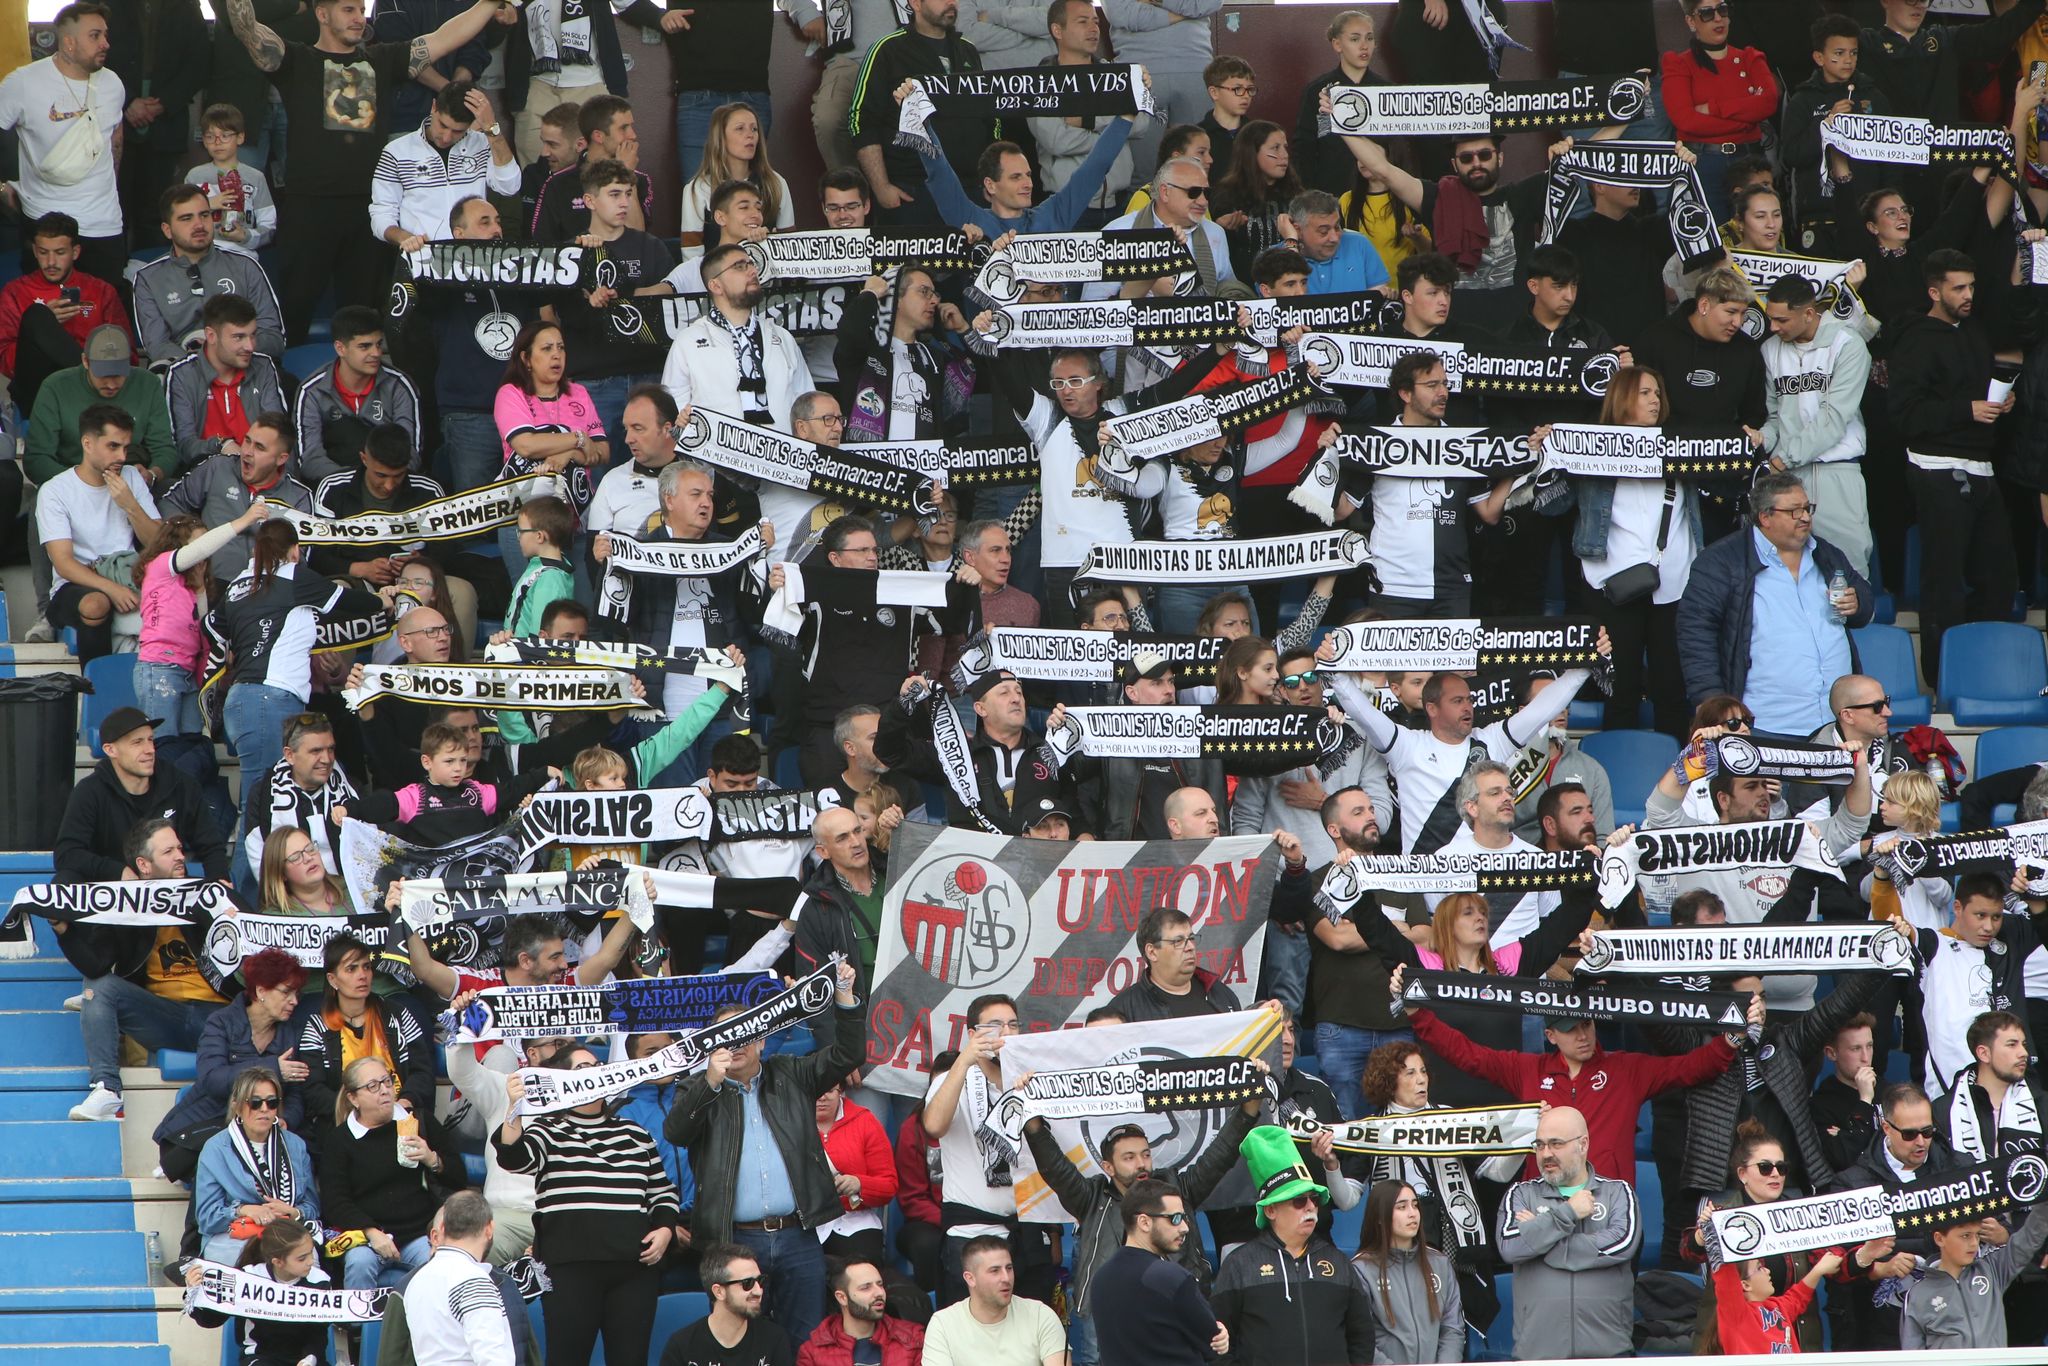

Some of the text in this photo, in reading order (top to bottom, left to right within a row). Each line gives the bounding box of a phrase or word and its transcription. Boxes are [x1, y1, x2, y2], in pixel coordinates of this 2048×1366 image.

[1087, 72, 1128, 93] VDS
[995, 96, 1059, 110] 1923 2013
[1379, 86, 1599, 117] UNIONISTAS de Salamanca C.F.
[1431, 122, 1447, 132] VDS
[1904, 122, 2004, 147] de Salamanca
[768, 233, 967, 261] UNIONISTAS de Salamanca C.F.
[1078, 239, 1096, 262] de
[1096, 238, 1170, 262] Salamanca
[402, 244, 583, 286] UNIONISTAS
[1021, 304, 1212, 330] UNIONISTAS de Salamanca
[1254, 300, 1372, 330] de Salamanca C.F.
[1074, 335, 1090, 344] VDS
[1457, 352, 1544, 378] Salamanca
[1546, 356, 1573, 379] C.F.
[1116, 368, 1301, 444] UNIONISTAS de Salamanca C.F.
[1339, 436, 1530, 468] UNIONISTAS
[1551, 430, 1742, 458] UNIONISTAS de Salamanca
[717, 422, 907, 494] UNIONISTAS de Salamanca C.F.
[920, 445, 1027, 472] de Salamanca
[390, 521, 420, 535] DE
[669, 553, 688, 569] DE
[1104, 540, 1328, 572] UNIONISTAS DE SALAMANCA CF
[998, 633, 1084, 661] UNIONISTAS
[1086, 638, 1107, 661] de
[1198, 638, 1224, 660] C.F.
[1361, 625, 1594, 652] UNIONISTAS de Salamanca C.F.
[1052, 667, 1068, 677] VDS
[1414, 658, 1431, 666] VDS
[476, 681, 506, 698] DE
[1489, 678, 1516, 702] C.F.
[1087, 713, 1308, 738] UNIONISTAS de Salamanca C.F.
[1758, 746, 1854, 766] UNIONISTAS
[1954, 838, 2014, 860] Salamanca
[1361, 851, 1585, 874] UNIONISTAS de Salamanca C.F.
[464, 880, 486, 890] DE
[1056, 858, 1261, 934] UNION
[432, 882, 630, 916] SALAMANCA
[240, 921, 322, 948] UNIONISTAS
[1624, 934, 1859, 962] UNIONISTAS DE SALAMANCA CF
[1520, 991, 1581, 1009] SOLO
[1588, 996, 1655, 1015] HUBO
[1662, 1002, 1712, 1020] UNA
[1024, 1060, 1256, 1100] UNIONISTAS de Salamanca C.F.
[1346, 1126, 1380, 1144] DE
[1445, 1162, 1460, 1178] CF
[1768, 1170, 2000, 1234] UNIONISTAS de Salamanca C.F.
[1831, 1230, 1849, 1241] VDS
